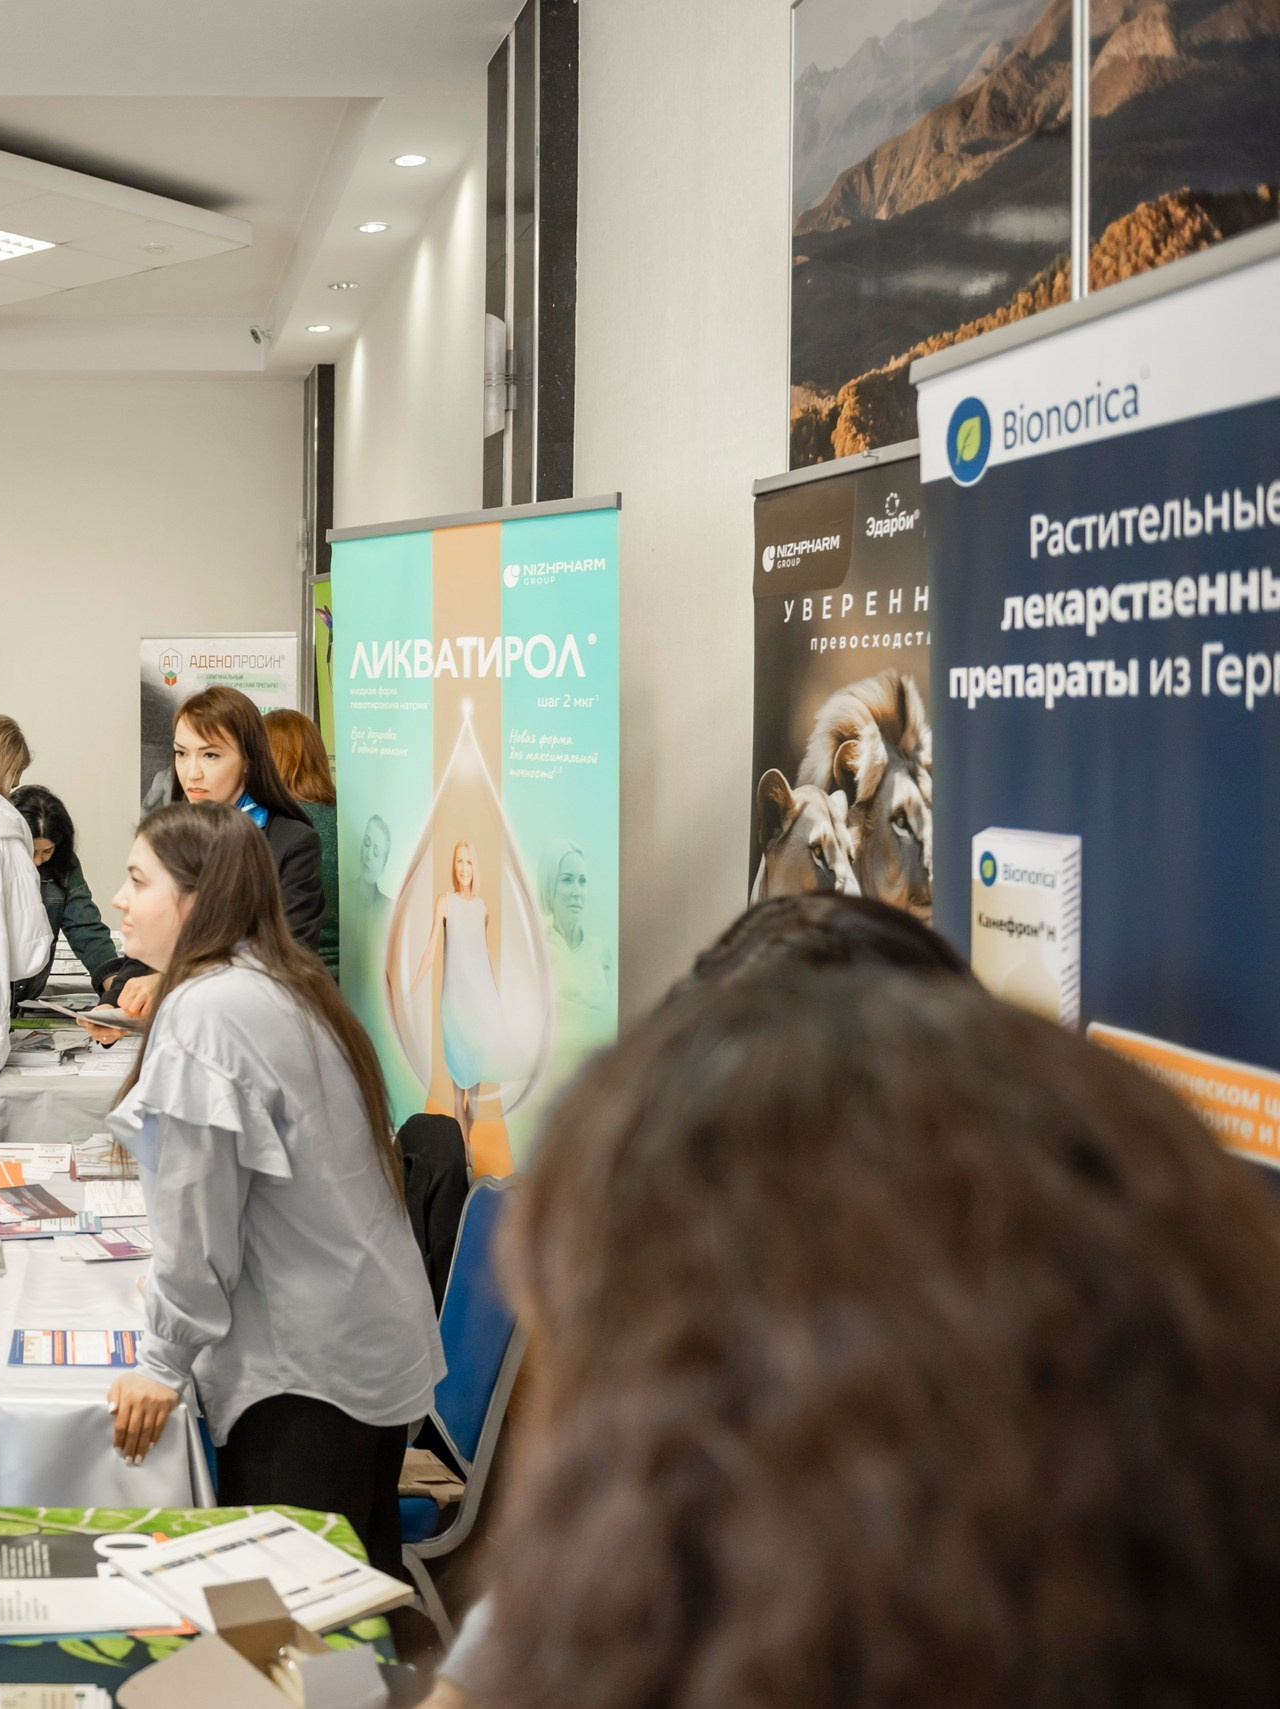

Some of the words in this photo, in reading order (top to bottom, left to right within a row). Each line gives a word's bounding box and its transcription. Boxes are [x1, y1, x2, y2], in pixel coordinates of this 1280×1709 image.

[1003, 381, 1139, 450] Bionorica
[1030, 479, 1280, 559] Растительные
[777, 535, 840, 557] NIZHPHARM
[523, 558, 606, 576] NIZHPHARM
[777, 558, 801, 569] GROUP
[523, 576, 556, 585] GROUP
[949, 658, 1139, 709] препараты
[1149, 656, 1190, 696] из
[1201, 642, 1280, 711] Гер
[537, 696, 560, 708] шаг
[563, 694, 570, 708] 2
[509, 728, 536, 745] Новая
[539, 734, 573, 749] форма
[509, 746, 523, 761] для
[526, 752, 599, 765] максимальной
